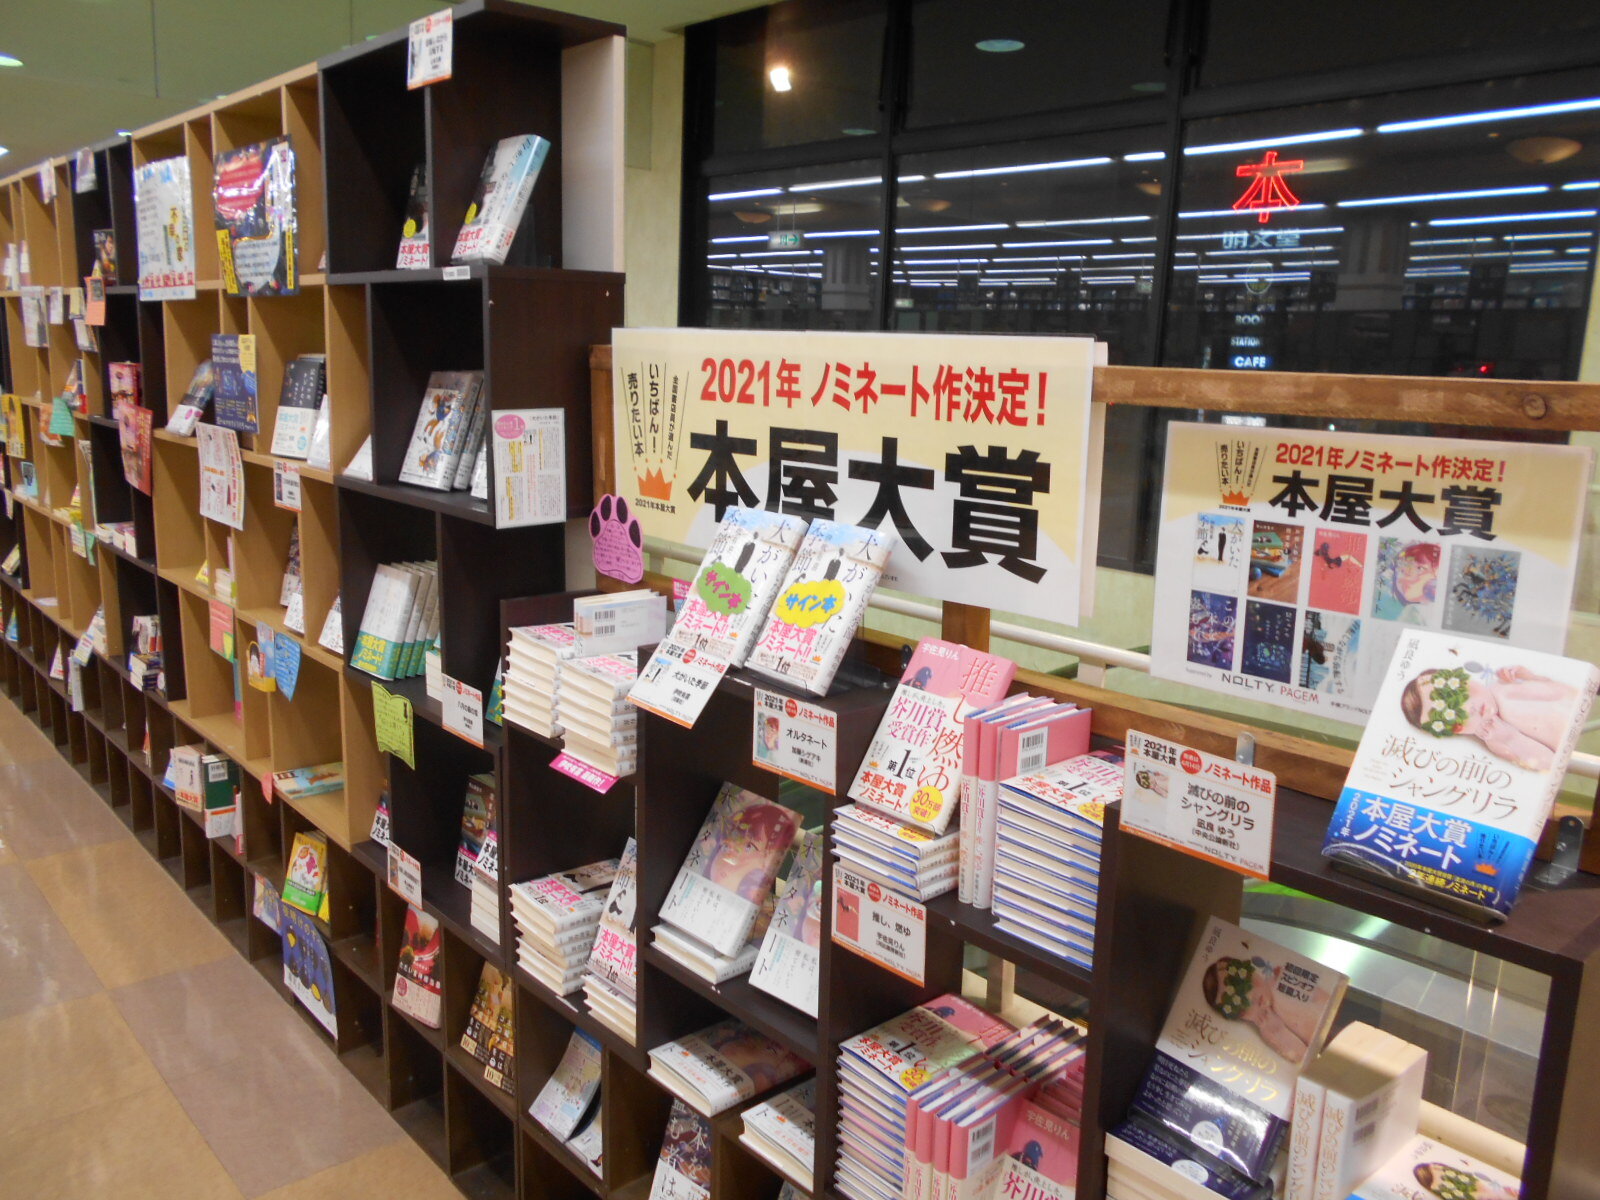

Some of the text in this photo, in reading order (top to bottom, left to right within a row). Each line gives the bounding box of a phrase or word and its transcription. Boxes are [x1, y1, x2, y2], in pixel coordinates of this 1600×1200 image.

[1232, 151, 1304, 223] 本
[1235, 314, 1265, 326] BOO
[1234, 356, 1266, 368] CAFE
[627, 373, 644, 457] 売りたい本
[649, 363, 660, 454] いちばん！
[635, 498, 676, 514] 2021年本屋大賞
[687, 419, 1050, 585] 本屋大賞
[1269, 470, 1502, 541] 本屋大賞
[706, 570, 742, 609] サイン本
[786, 594, 837, 613] サイン本
[770, 619, 819, 646] 本屋大賞
[922, 643, 959, 661] 宇佐見りん
[1221, 672, 1320, 704] NOLTY PAGEM
[799, 707, 835, 728] ノミネート作品
[890, 696, 947, 733] 芥川賞
[786, 728, 827, 750] オルタネート
[887, 719, 932, 748] 受賞作
[1144, 739, 1177, 756] 2021年
[886, 749, 917, 780] 第1位
[1143, 748, 1177, 767] 本屋大賞
[1382, 733, 1514, 790] 滅びの前の
[861, 771, 907, 797] 本屋大賞
[1204, 763, 1272, 794] ノミネート作品
[1187, 782, 1250, 813] 滅びの前の
[1387, 768, 1520, 821] シャングリラ
[1181, 796, 1255, 831] シャングリラ
[1340, 792, 1361, 837] 2021年
[1361, 797, 1473, 848] 本屋大賞
[1196, 818, 1215, 832] 凪良
[1217, 825, 1235, 839] ゆう
[1204, 845, 1237, 862] NOLTY
[1353, 824, 1462, 870] ノミネート
[844, 872, 865, 886] 2021年
[844, 880, 865, 895] 本屋大賞
[883, 894, 924, 921] ノミネート作品
[872, 911, 911, 937] 推し、燃ゆ
[601, 929, 637, 958] 本屋大賞
[877, 931, 905, 951] 宇佐見りん
[1281, 972, 1315, 992] スピンオフ
[1027, 1110, 1069, 1141] 宇佐見りん
[1003, 1171, 1061, 1200] 芥川
